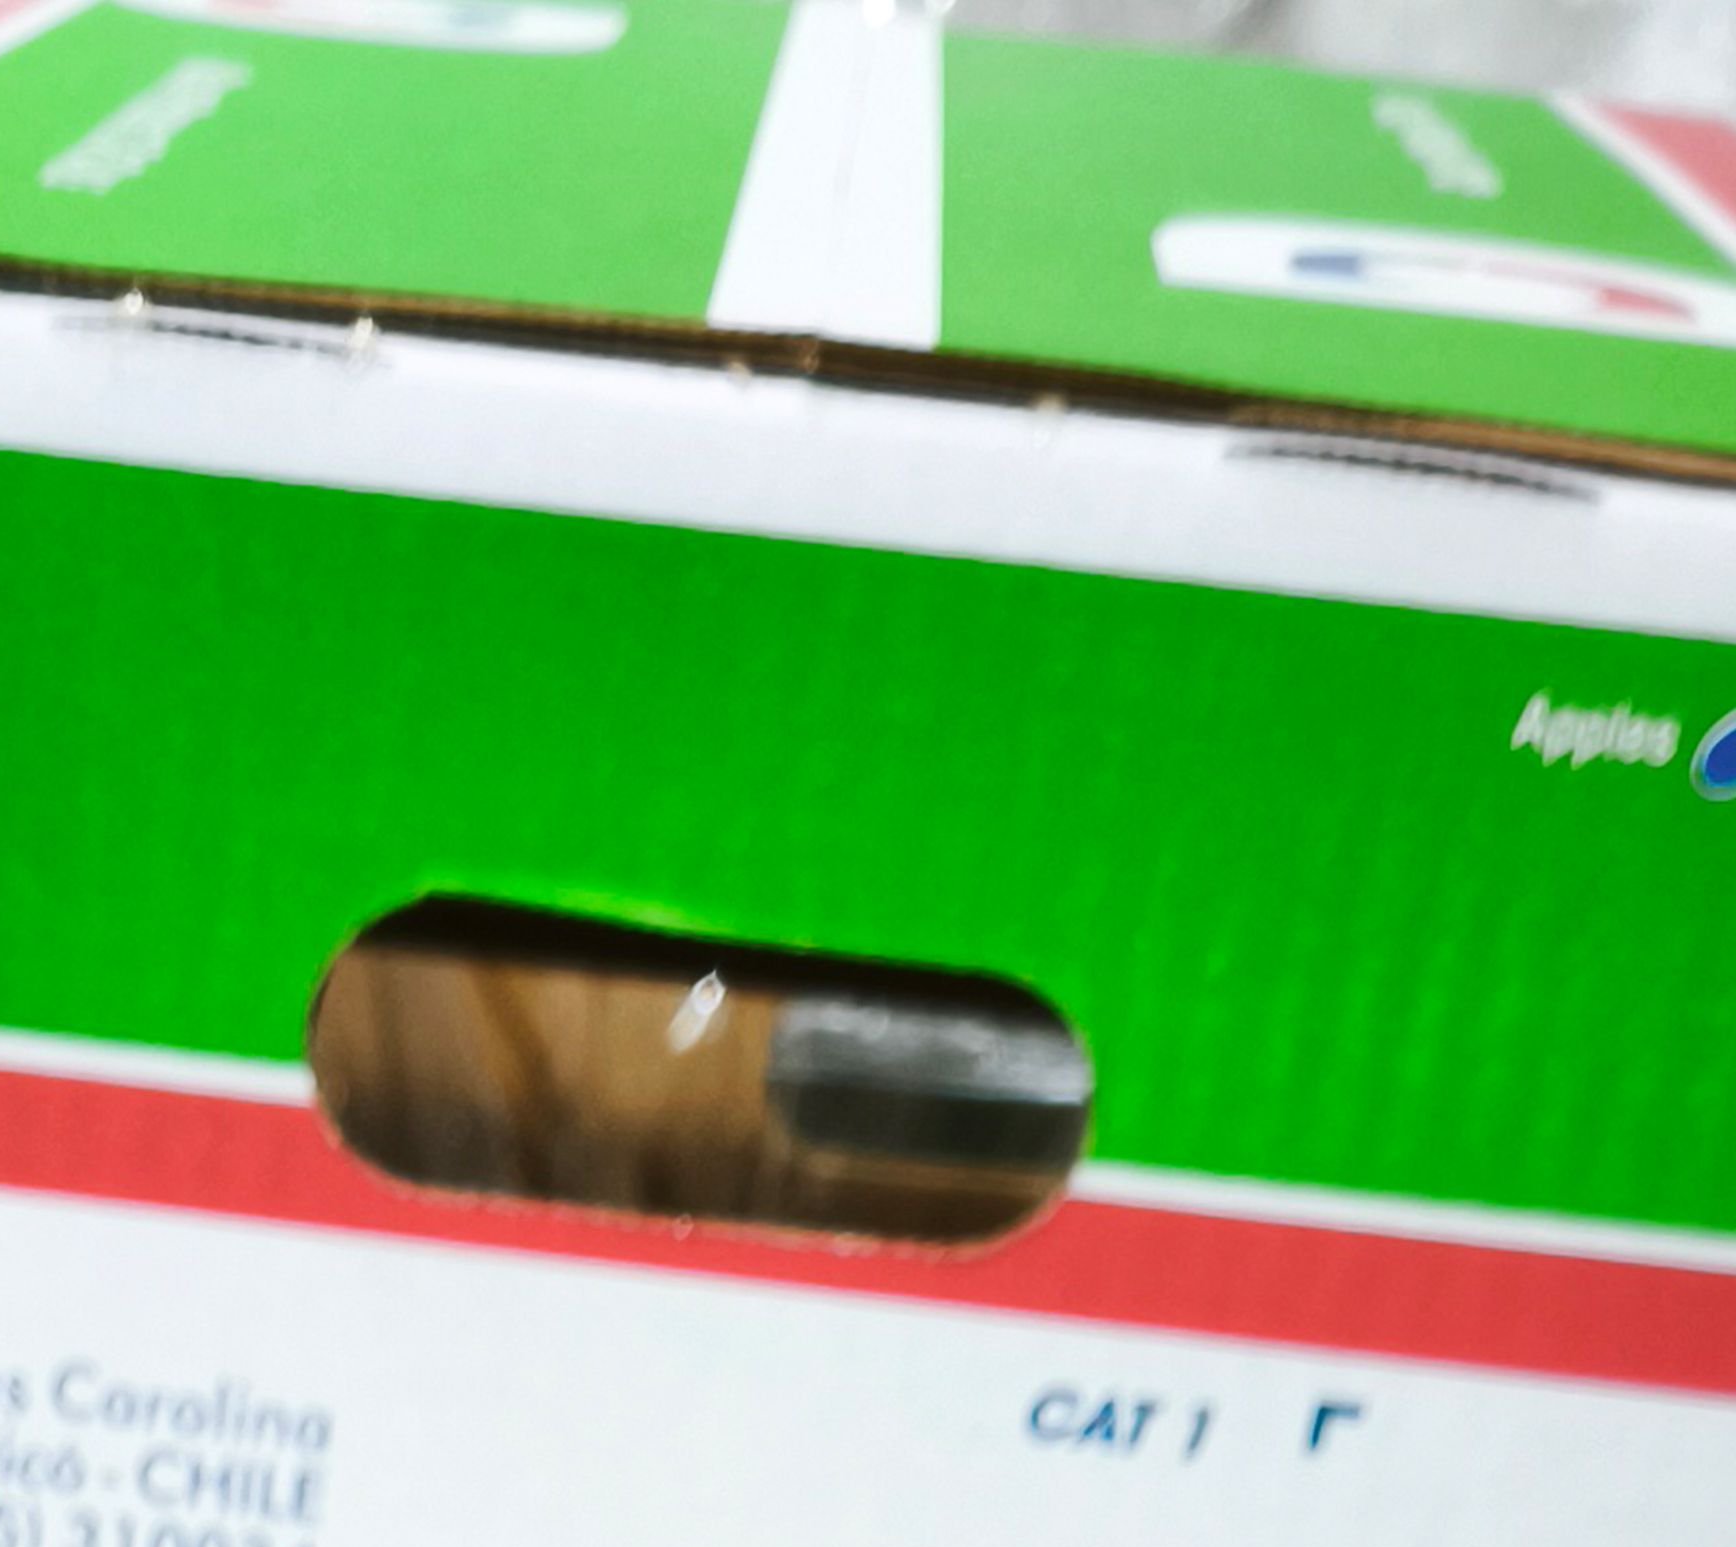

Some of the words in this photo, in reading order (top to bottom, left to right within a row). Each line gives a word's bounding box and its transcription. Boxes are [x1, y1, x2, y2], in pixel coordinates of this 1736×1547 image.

[1510, 690, 1680, 770] Apples
[49, 1356, 332, 1452] Carolina
[1028, 1384, 1158, 1448] CAT
[134, 1445, 322, 1522] CHILE
